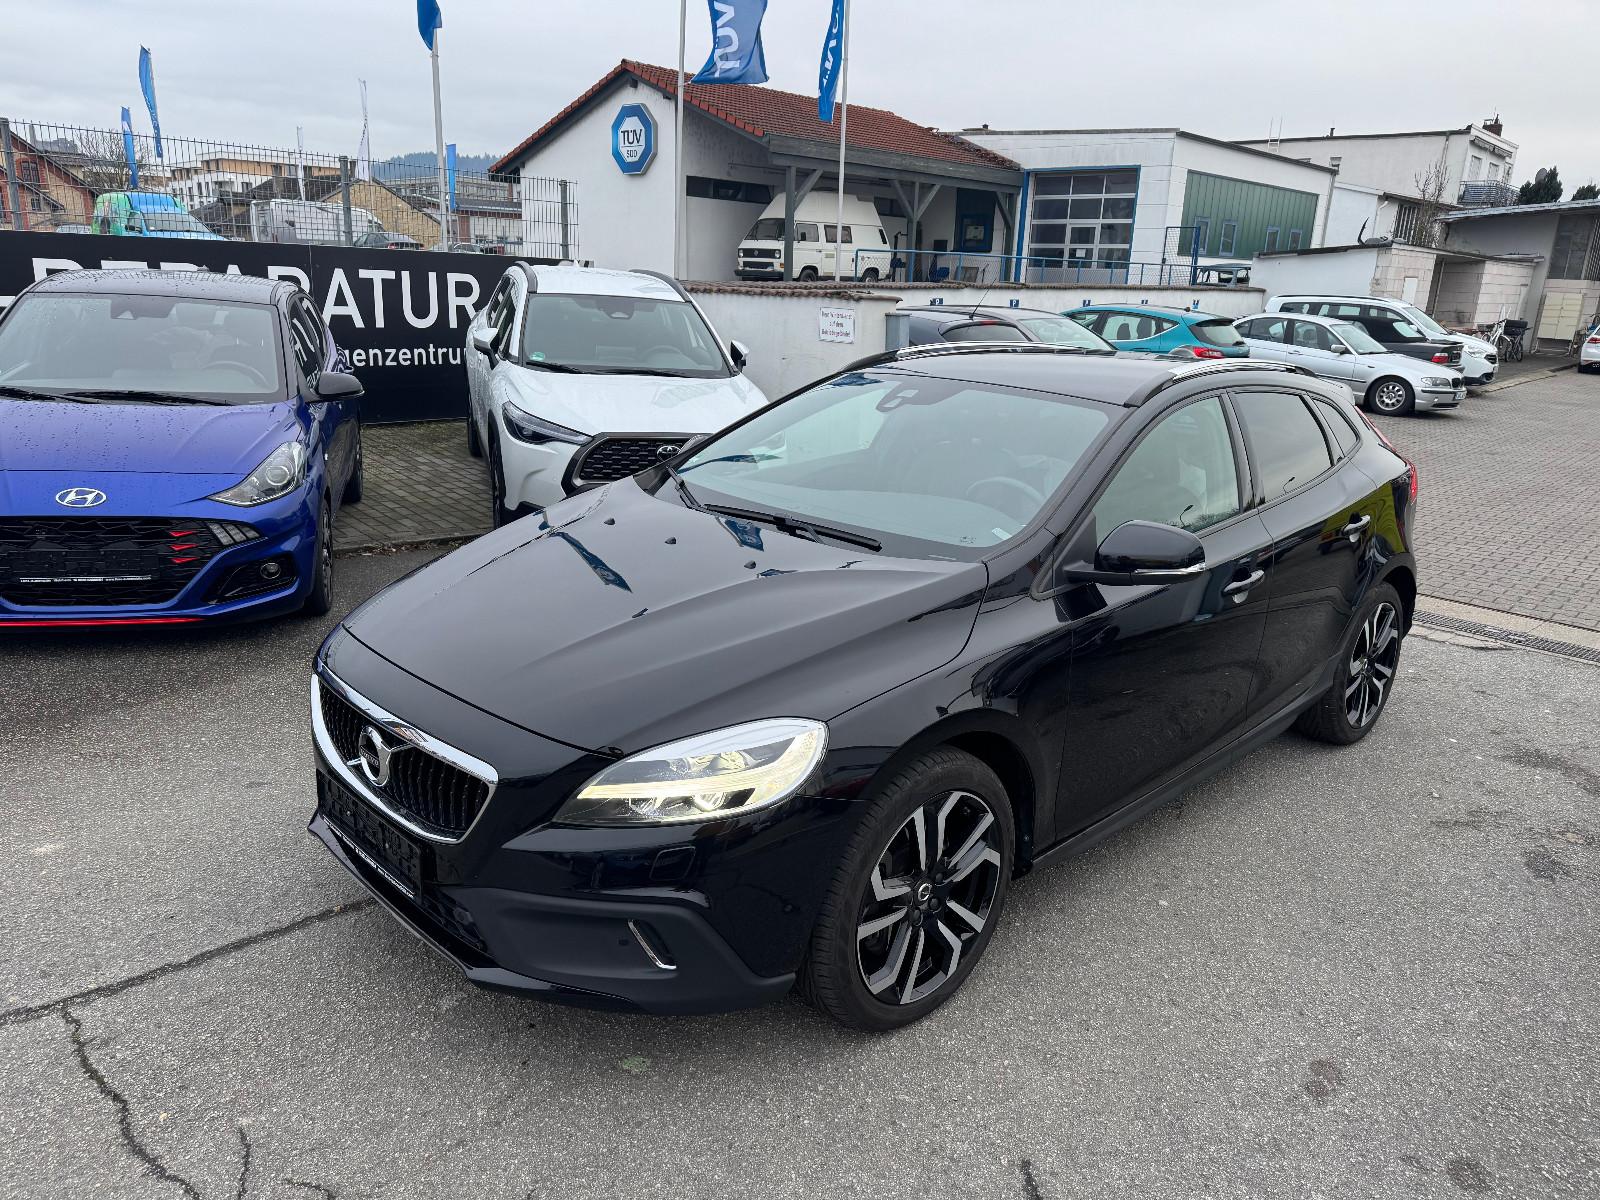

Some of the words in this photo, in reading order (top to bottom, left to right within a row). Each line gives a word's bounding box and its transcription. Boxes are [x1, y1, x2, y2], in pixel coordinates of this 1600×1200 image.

[713, 0, 741, 78] TÜV
[620, 128, 643, 146] TÜV
[32, 257, 481, 329] RATUR
